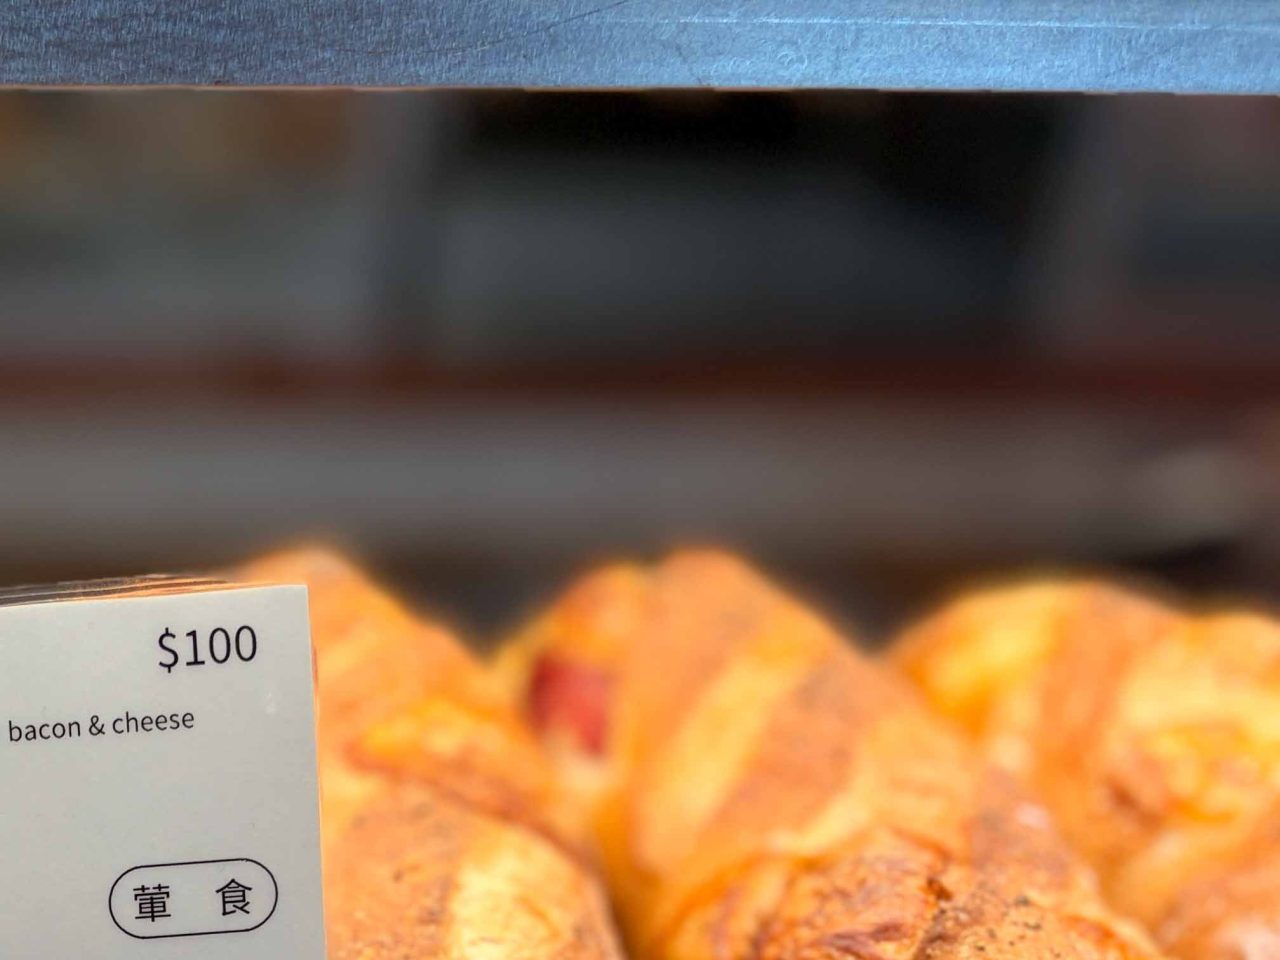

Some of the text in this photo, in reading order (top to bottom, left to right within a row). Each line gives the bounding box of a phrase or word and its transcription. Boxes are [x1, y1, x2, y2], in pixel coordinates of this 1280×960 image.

[158, 625, 257, 674] $100
[8, 720, 81, 743] bacon
[88, 714, 106, 737] &
[112, 711, 195, 735] cheese
